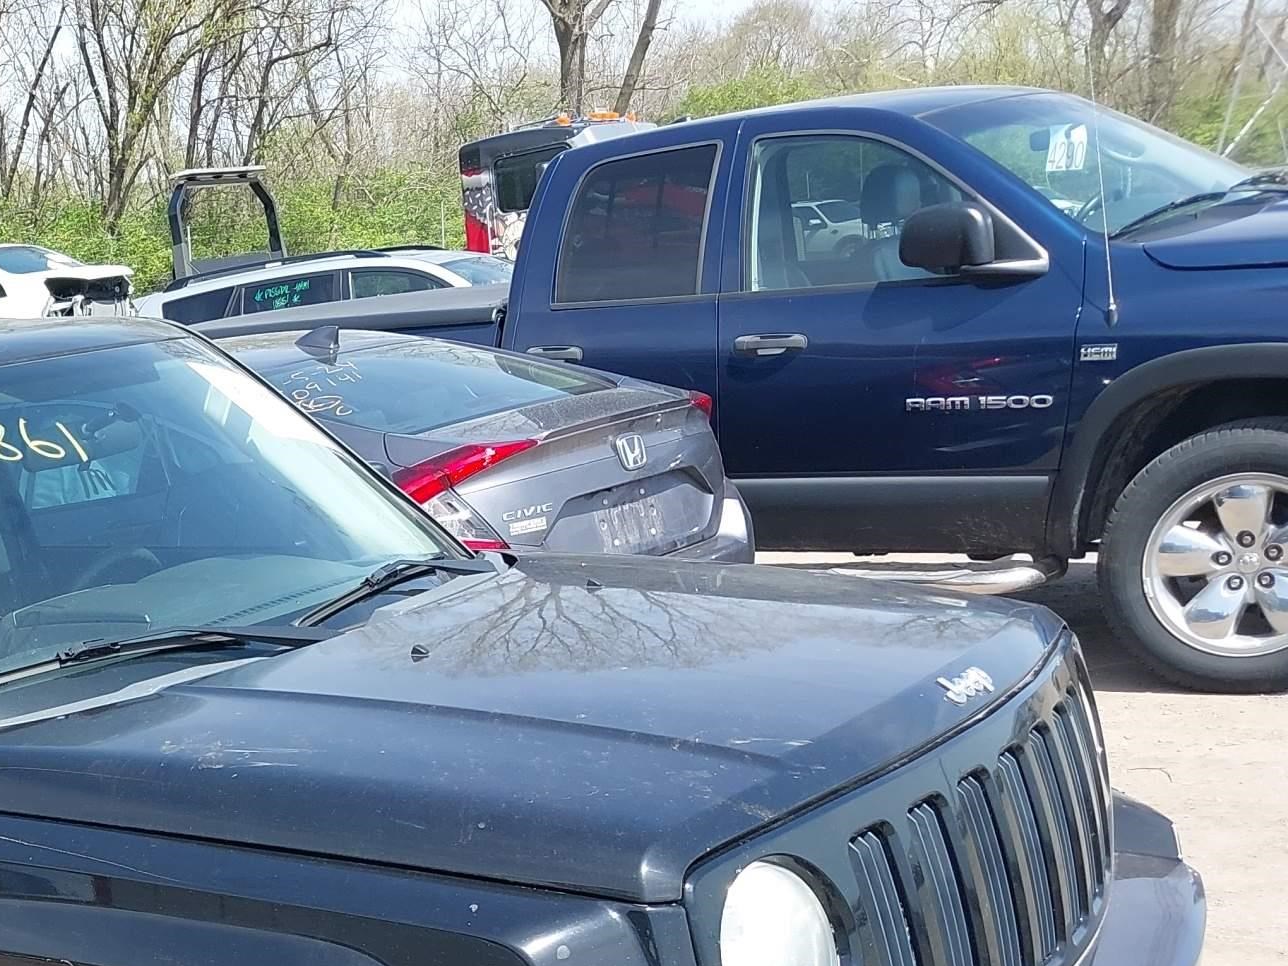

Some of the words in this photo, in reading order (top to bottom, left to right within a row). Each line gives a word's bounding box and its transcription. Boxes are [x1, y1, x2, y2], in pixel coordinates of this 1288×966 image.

[1047, 141, 1085, 169] 4290
[906, 396, 970, 412] RAM
[978, 394, 1054, 410] 1500
[502, 502, 553, 521] CIVIC
